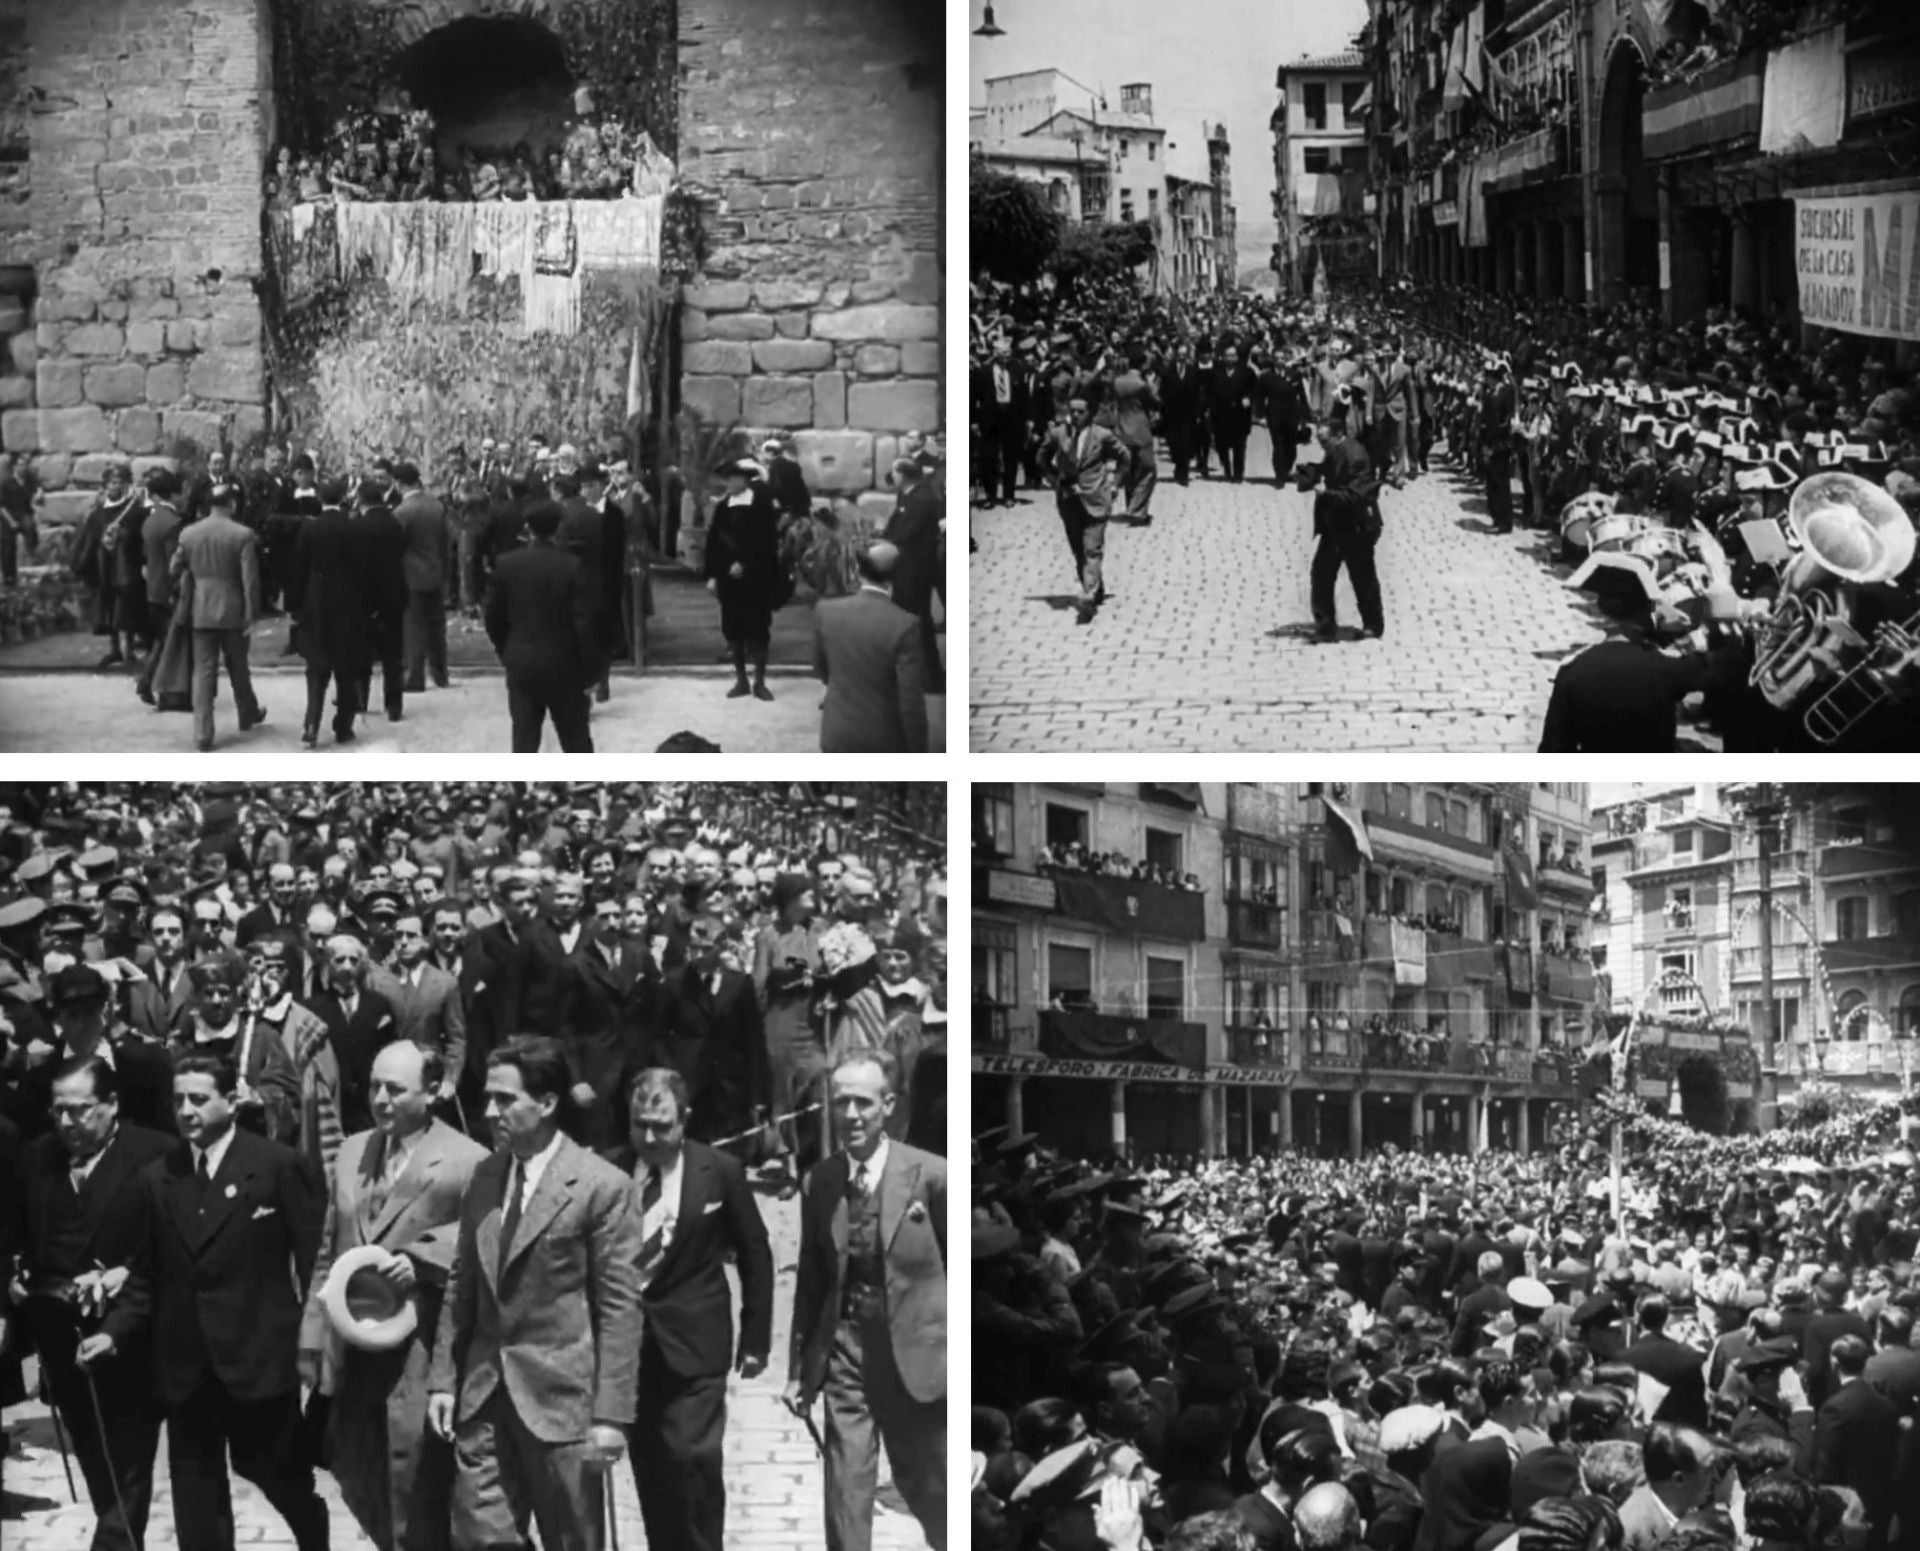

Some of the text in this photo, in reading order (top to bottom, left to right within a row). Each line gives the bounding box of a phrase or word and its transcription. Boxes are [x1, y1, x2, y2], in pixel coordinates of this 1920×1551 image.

[1801, 208, 1855, 241] SUCURSAL
[1800, 248, 1811, 273] DE
[1827, 250, 1854, 276] CASA
